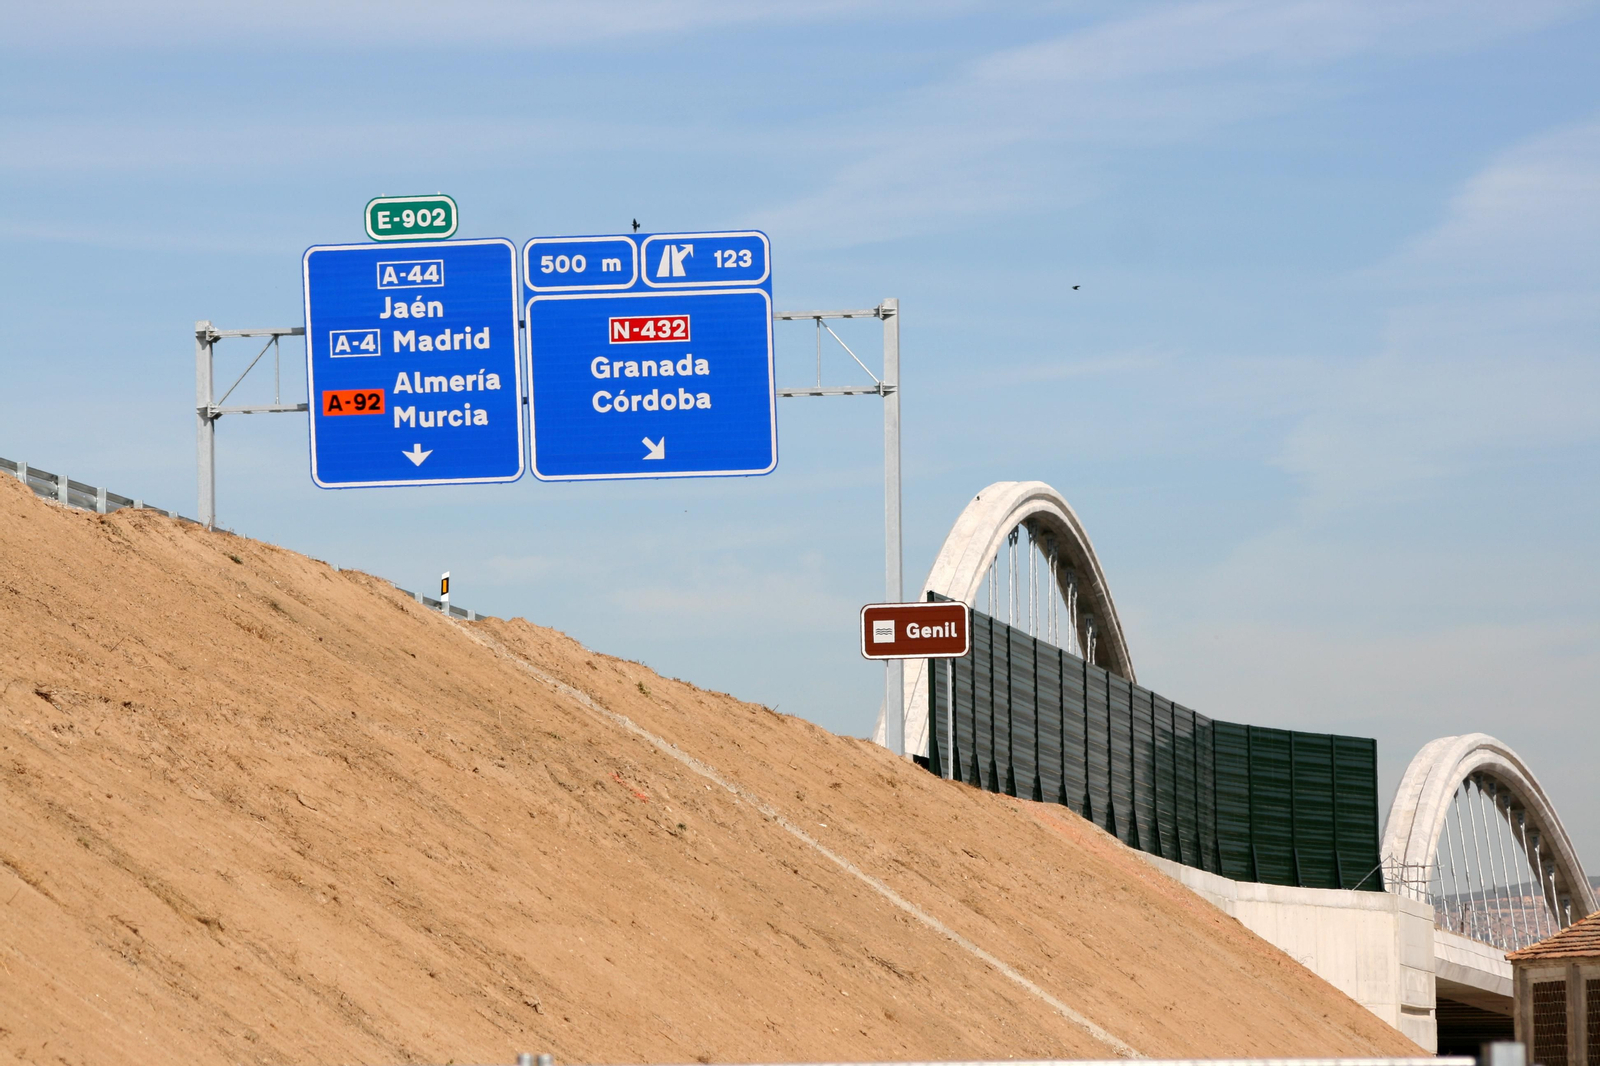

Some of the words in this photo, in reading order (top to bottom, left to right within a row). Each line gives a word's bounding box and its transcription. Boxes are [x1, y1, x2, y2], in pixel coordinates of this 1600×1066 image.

[377, 208, 446, 229] E-902
[540, 254, 587, 274] 500
[602, 257, 622, 272] m
[714, 249, 752, 268] 123
[382, 264, 440, 285] A-44
[380, 295, 444, 319] Jaén
[393, 326, 490, 353] Madrid
[613, 319, 686, 340] N-432
[335, 334, 376, 353] A-4
[590, 353, 710, 379] Granada
[393, 369, 501, 394] Almería
[327, 393, 381, 412] A-92
[592, 387, 712, 413] Córdoba
[393, 403, 489, 428] Murcia
[906, 622, 957, 639] Genil
